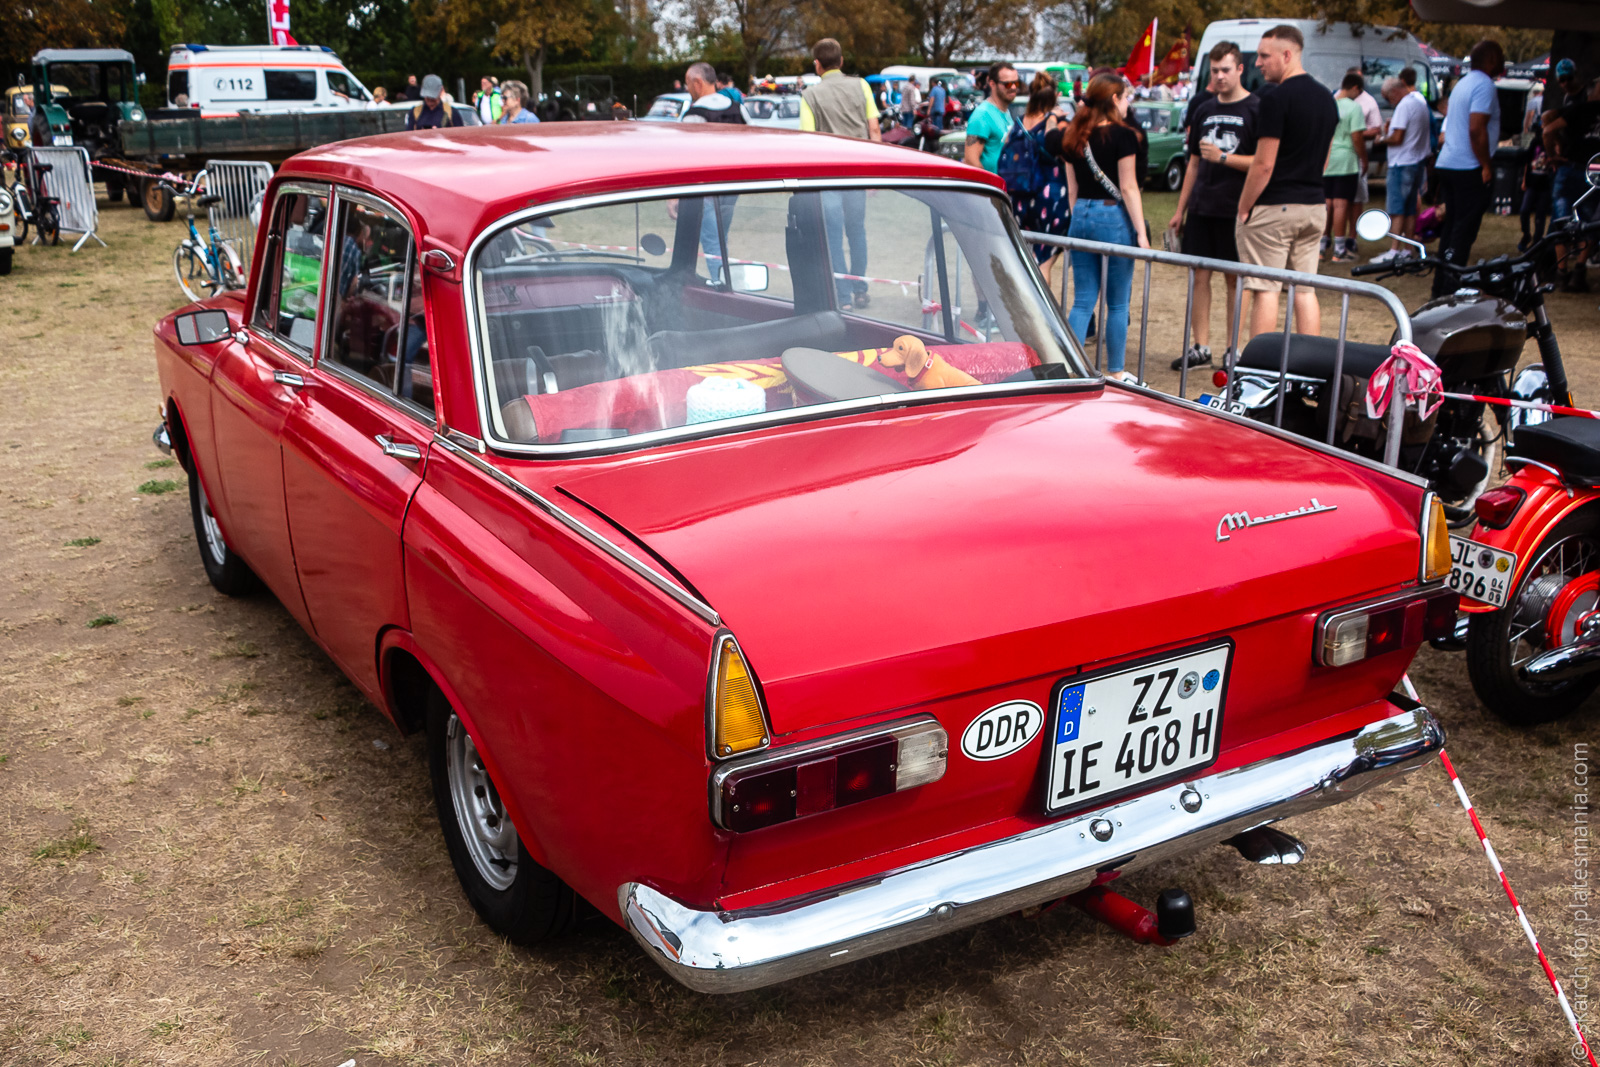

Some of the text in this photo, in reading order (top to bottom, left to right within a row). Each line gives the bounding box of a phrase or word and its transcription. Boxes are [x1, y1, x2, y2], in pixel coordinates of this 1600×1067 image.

[229, 78, 253, 90] 112
[1451, 542, 1474, 568] JL
[1449, 568, 1486, 598] 896
[1491, 577, 1503, 590] 04
[1488, 591, 1501, 604] 09
[1128, 668, 1179, 725] ZZ
[976, 710, 1030, 752] DDR
[1064, 720, 1074, 736] D
[1057, 708, 1213, 800] IE 408 H
